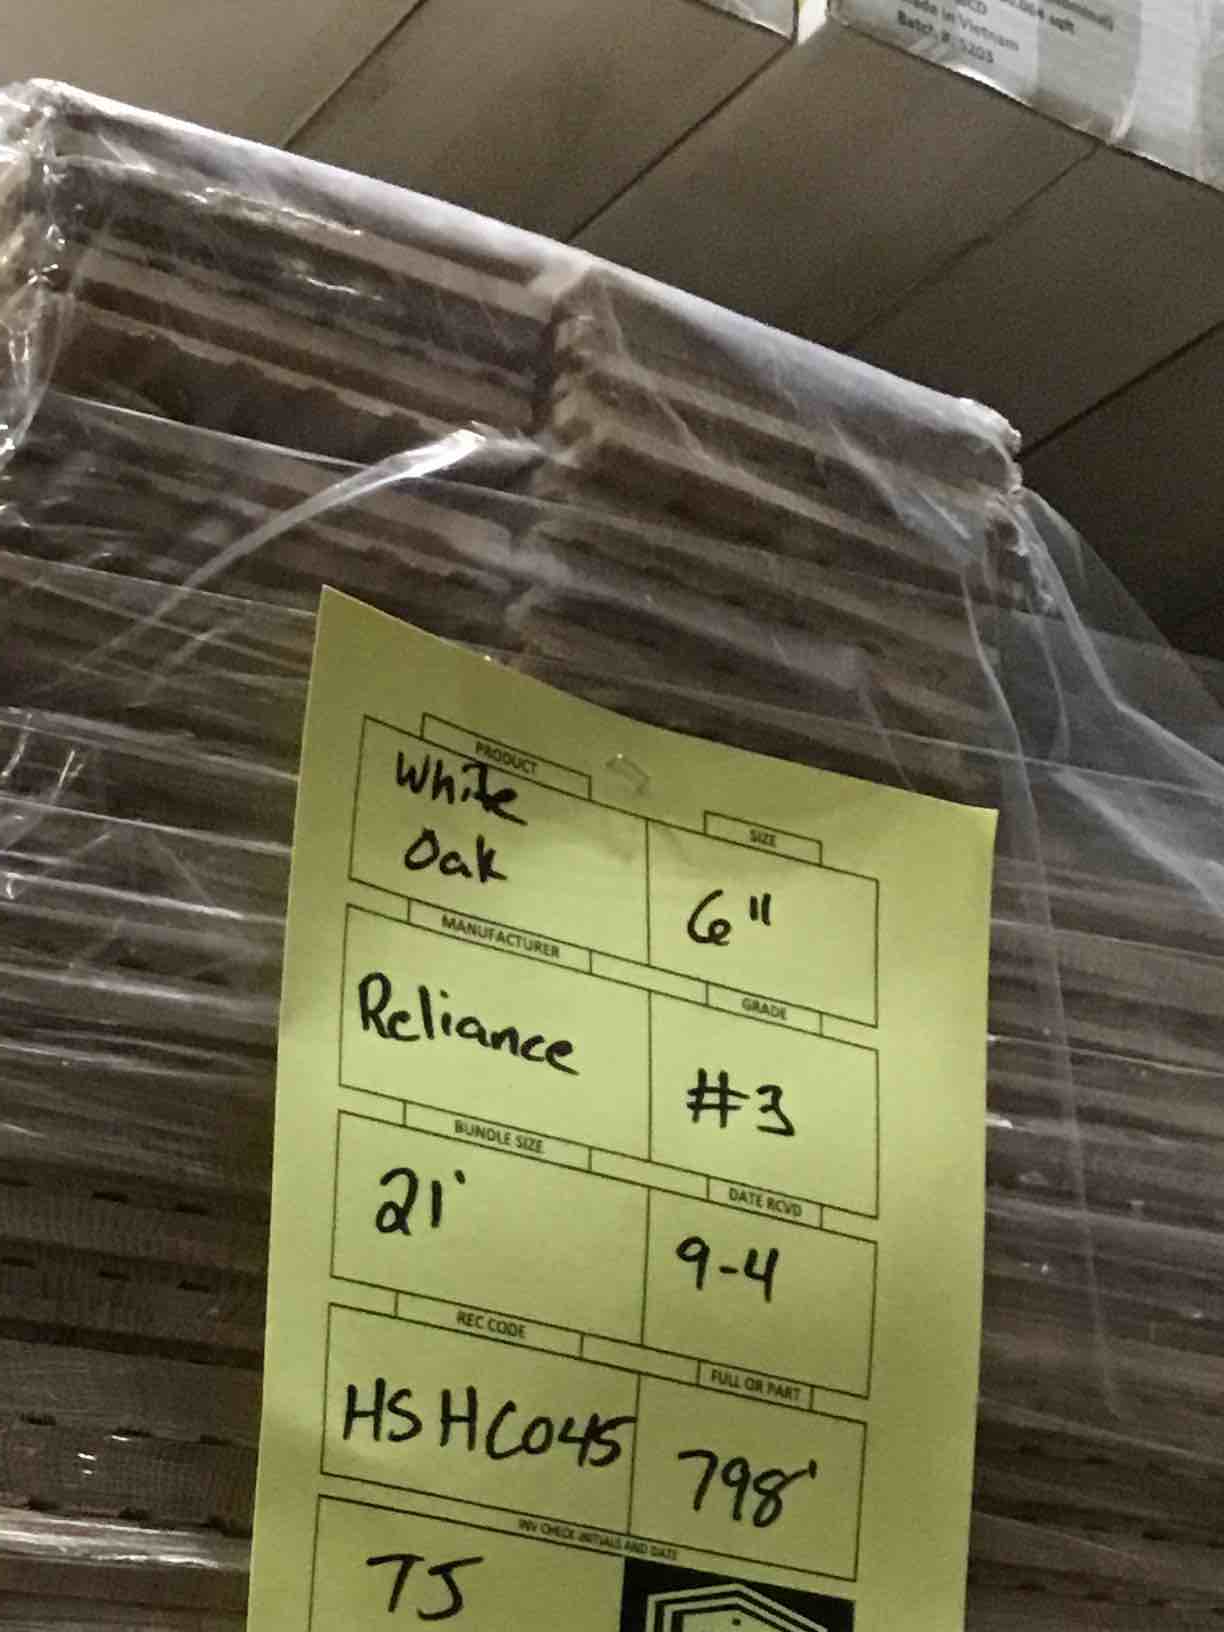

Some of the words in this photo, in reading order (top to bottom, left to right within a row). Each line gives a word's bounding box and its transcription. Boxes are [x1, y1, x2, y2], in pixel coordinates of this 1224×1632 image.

[476, 741, 537, 775] PRODUCT
[396, 750, 528, 826] White
[749, 828, 778, 847] SIZE
[404, 828, 509, 883] Oak
[441, 914, 561, 959] MANUFACTURER
[358, 971, 580, 1076] Reliance
[741, 998, 788, 1021] GRADE
[686, 1068, 795, 1137] #3
[454, 1120, 510, 1148] BUNDLE
[512, 1133, 544, 1154] SIZE
[728, 1186, 763, 1207] DATE
[765, 1195, 803, 1218] RCVD
[677, 1235, 780, 1303] 9-4
[457, 1310, 484, 1330] REC
[487, 1317, 526, 1339] CODE
[711, 1368, 741, 1388] FULL
[744, 1375, 764, 1392] OR
[766, 1379, 801, 1401] PART
[540, 1522, 575, 1540] CHECK
[624, 1540, 648, 1554] AND
